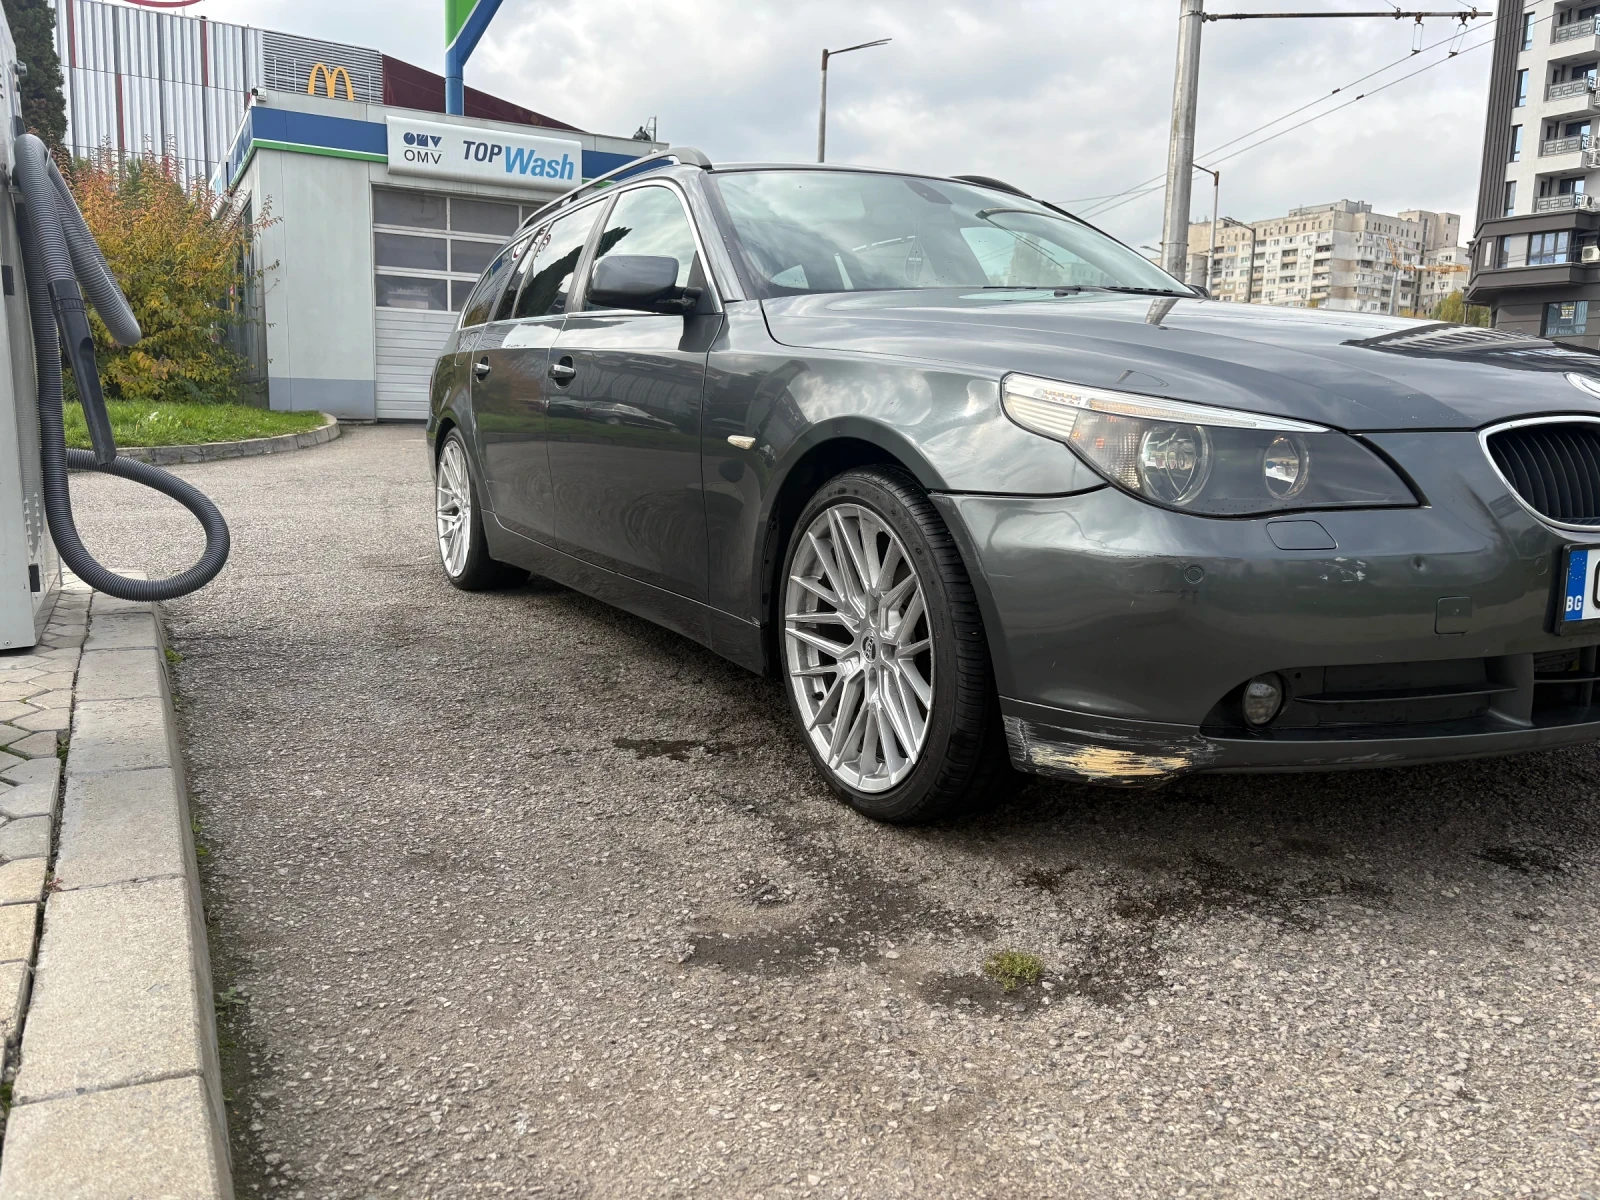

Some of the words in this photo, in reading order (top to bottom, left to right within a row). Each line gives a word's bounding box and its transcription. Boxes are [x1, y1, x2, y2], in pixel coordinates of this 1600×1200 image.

[403, 149, 442, 165] OMV
[463, 140, 503, 163] TOP
[505, 146, 575, 180] Wash
[1566, 595, 1582, 612] BG
